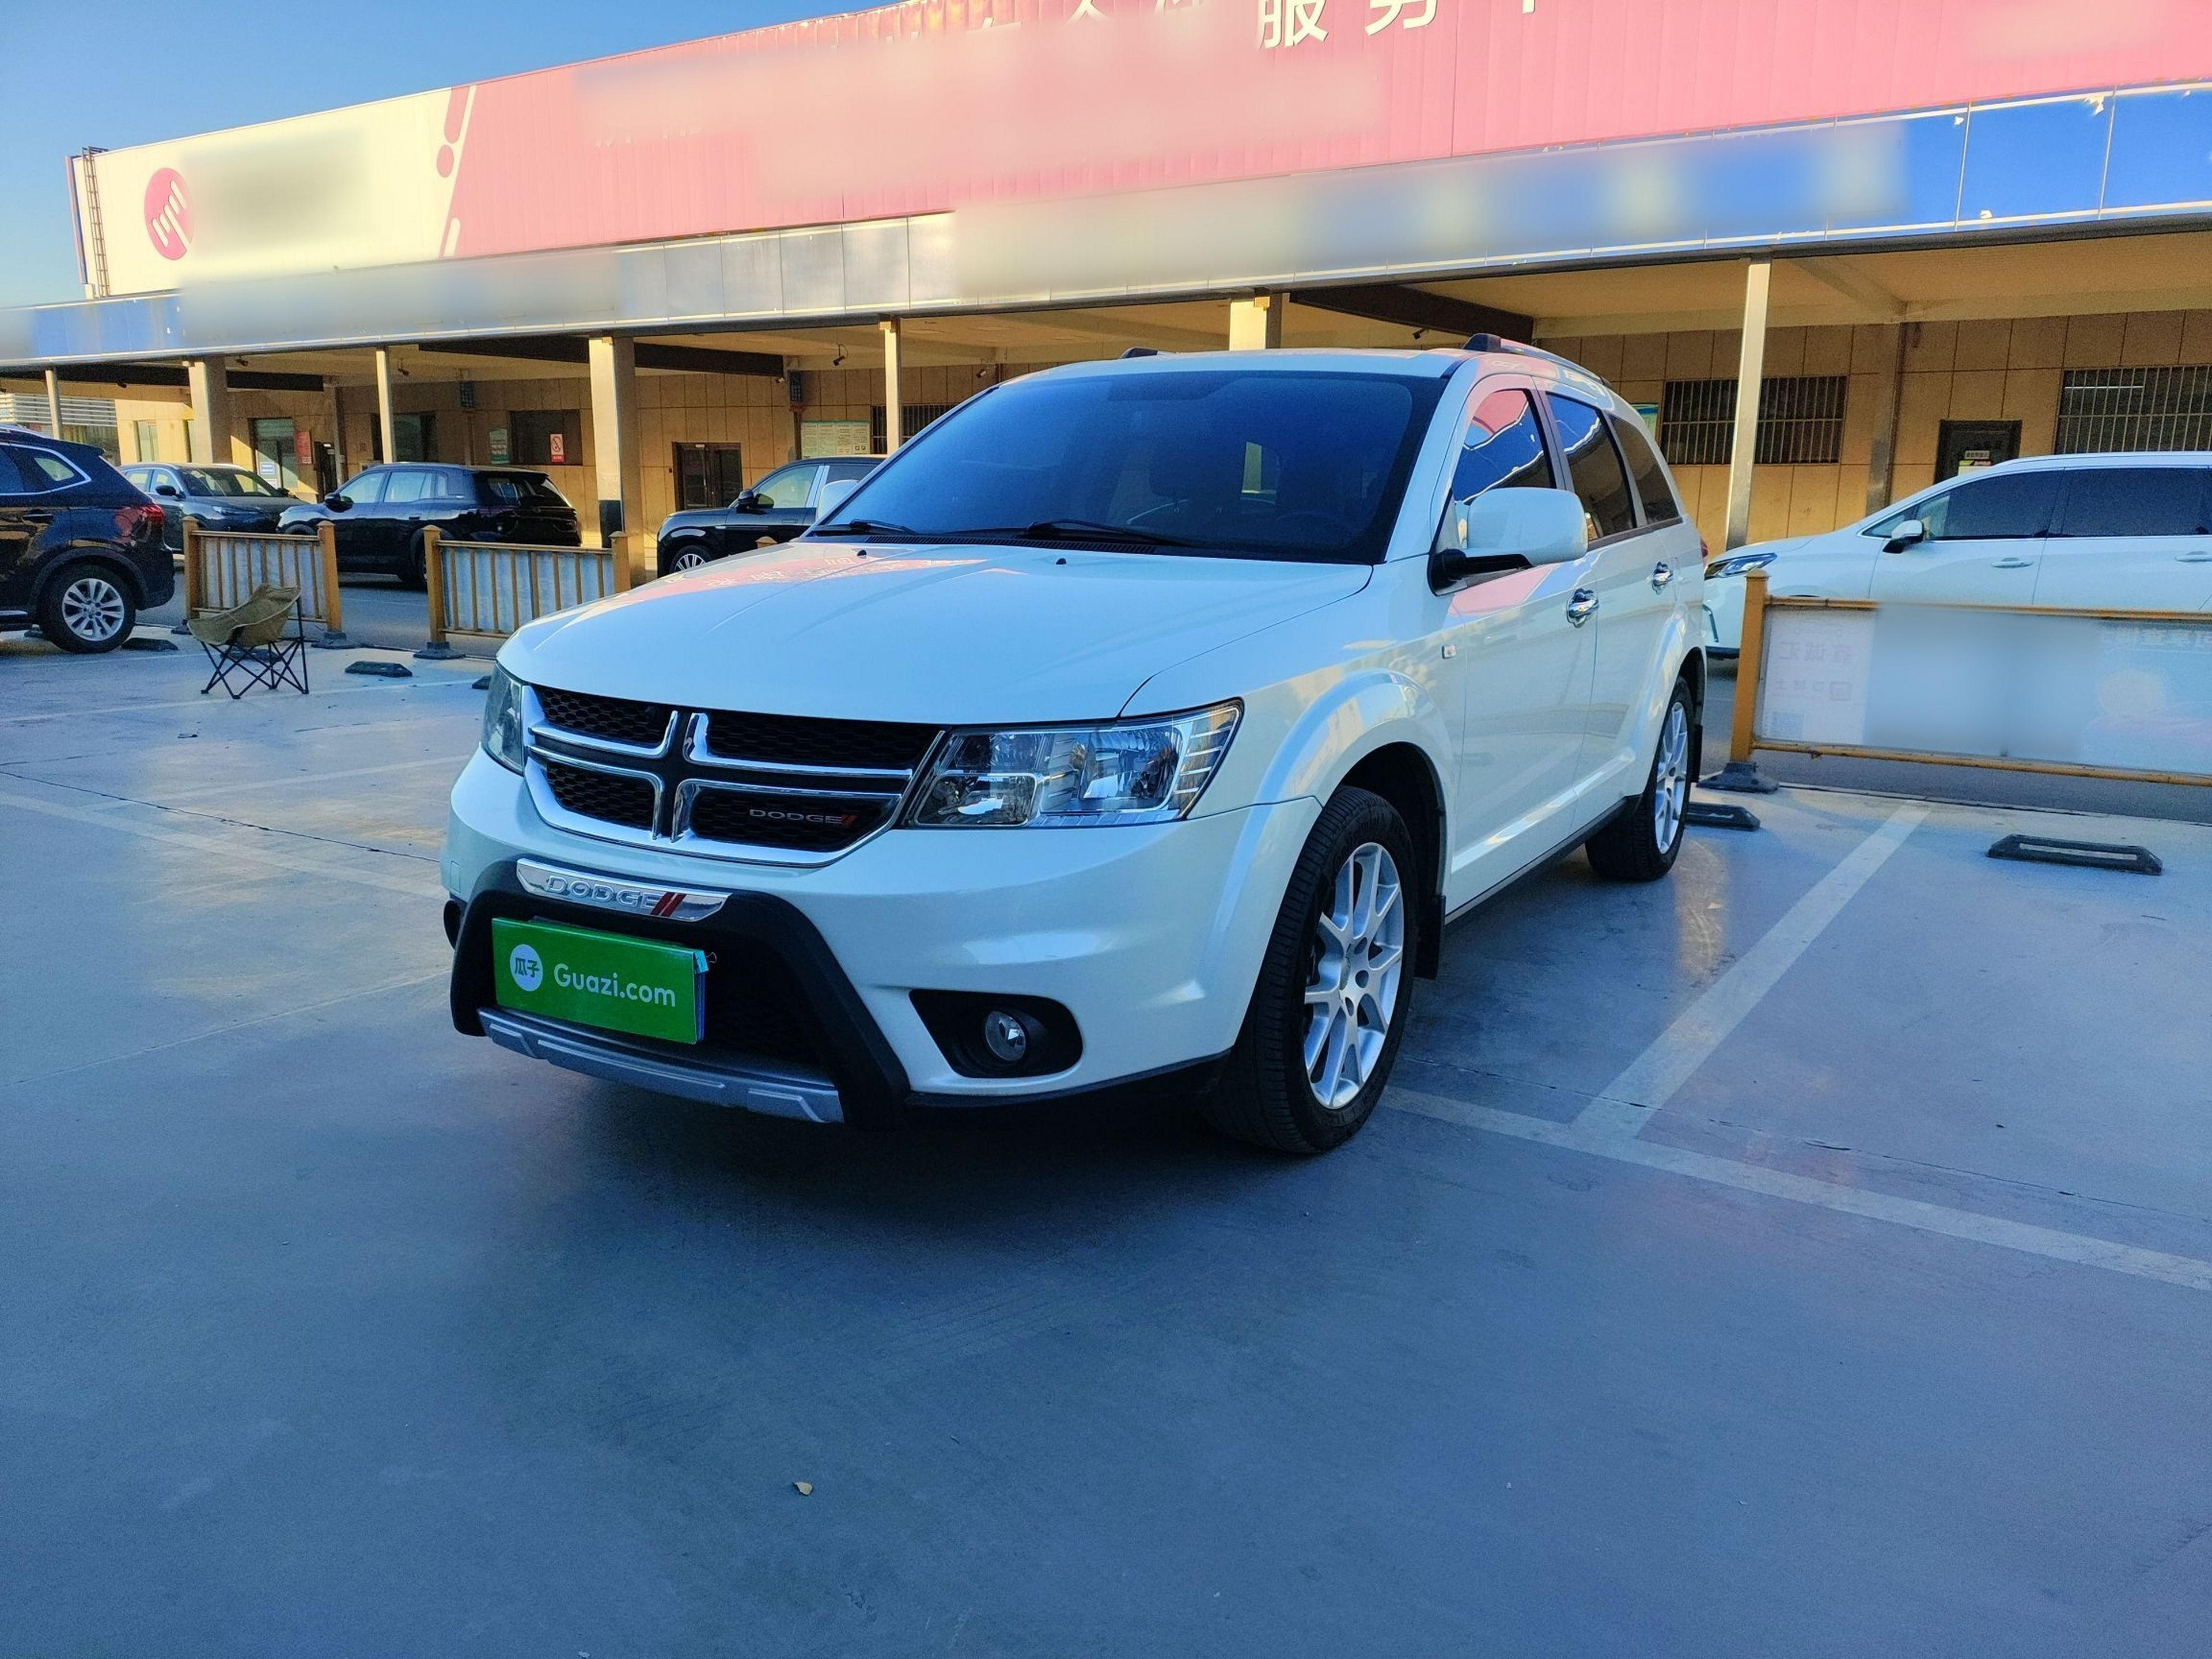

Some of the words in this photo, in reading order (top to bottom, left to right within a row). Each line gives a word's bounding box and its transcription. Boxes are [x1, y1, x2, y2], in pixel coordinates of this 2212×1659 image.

[749, 809, 843, 824] DODGE
[547, 874, 662, 909] DODGE
[514, 956, 539, 978] 瓜子
[553, 963, 676, 1007] Guazi.com
